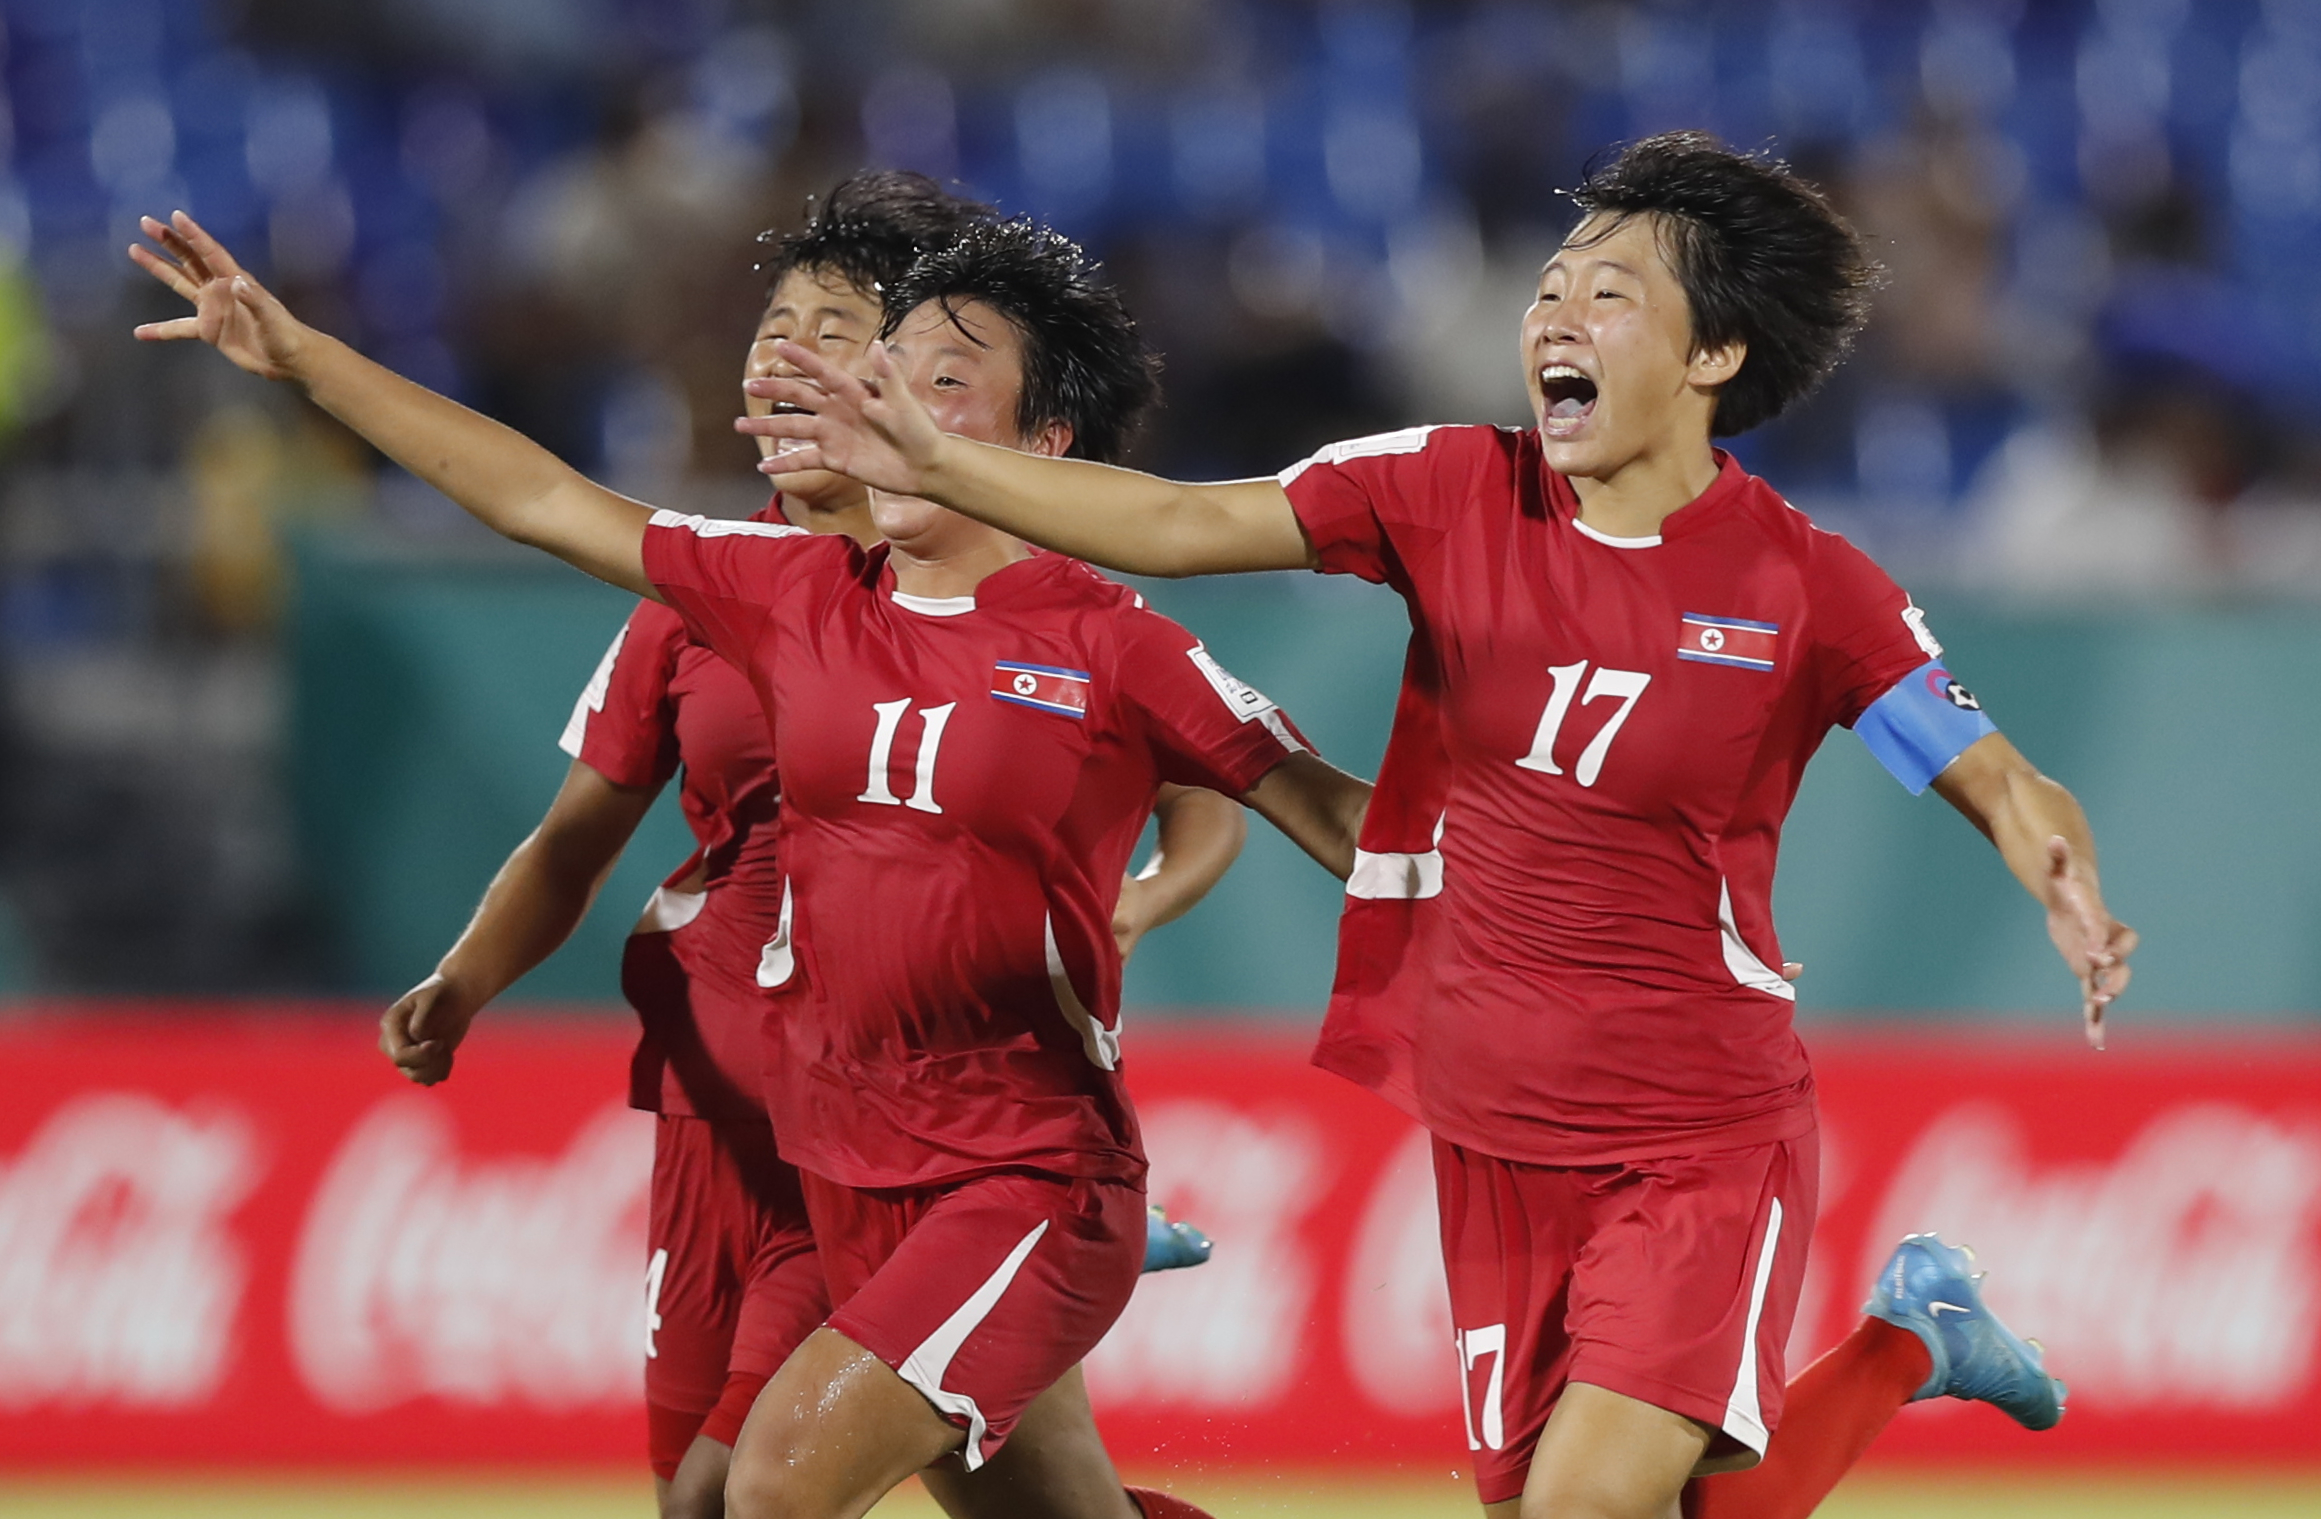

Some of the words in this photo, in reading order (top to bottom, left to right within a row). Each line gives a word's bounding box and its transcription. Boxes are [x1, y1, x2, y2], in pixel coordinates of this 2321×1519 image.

[857, 697, 957, 815] 11
[1514, 658, 1652, 788] 17
[1455, 1322, 1507, 1452] 17
